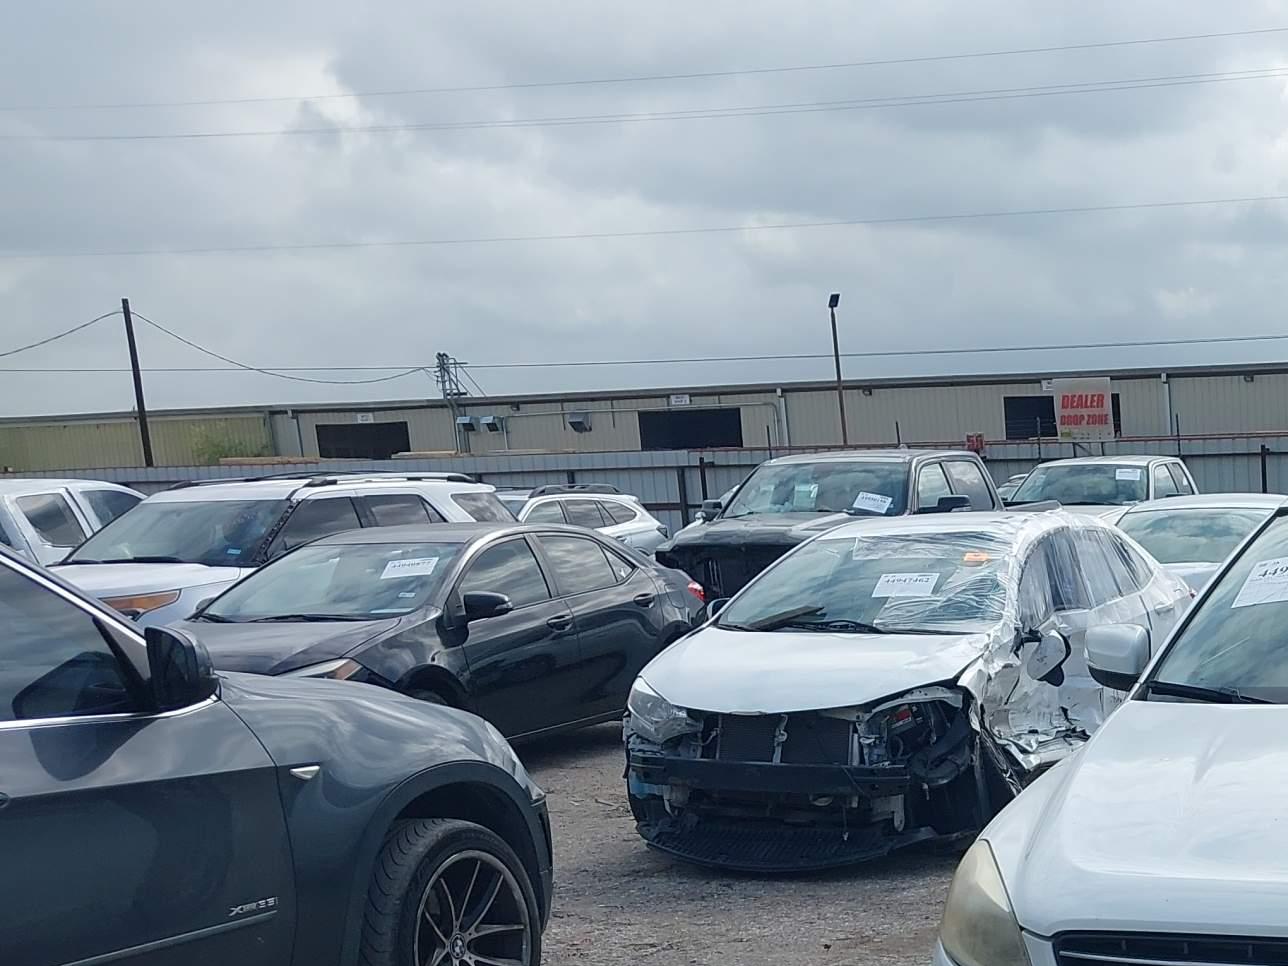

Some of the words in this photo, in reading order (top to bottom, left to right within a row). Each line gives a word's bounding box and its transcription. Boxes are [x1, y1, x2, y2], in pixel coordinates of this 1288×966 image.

[1061, 394, 1105, 409] DEALER
[1060, 414, 1085, 426] DROP
[1086, 414, 1109, 425] ZONE
